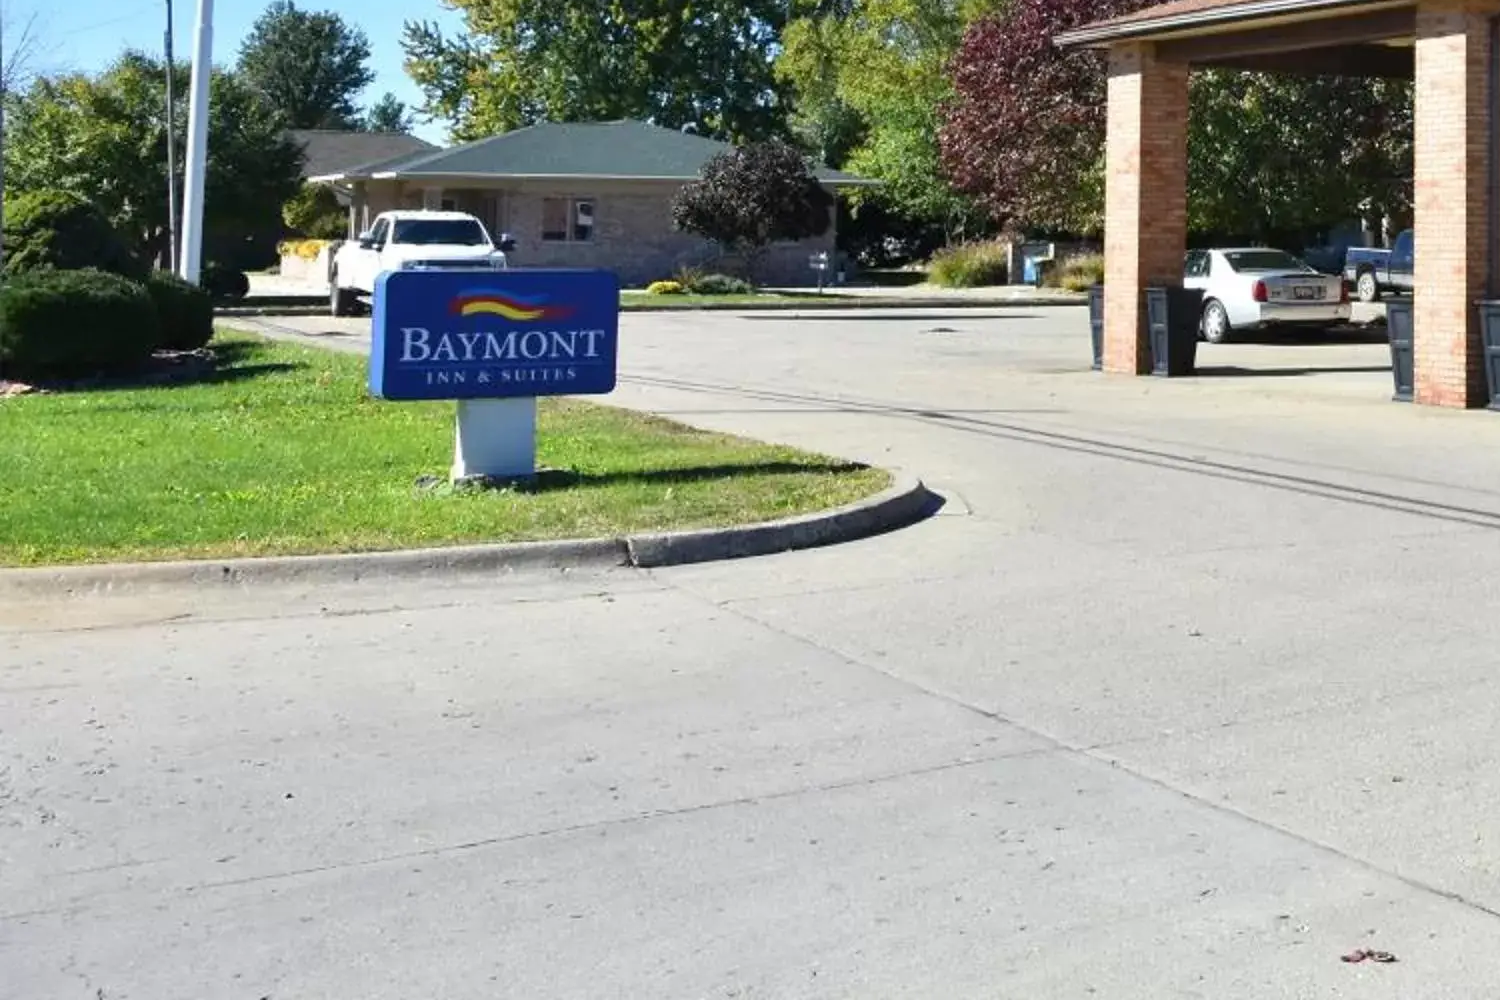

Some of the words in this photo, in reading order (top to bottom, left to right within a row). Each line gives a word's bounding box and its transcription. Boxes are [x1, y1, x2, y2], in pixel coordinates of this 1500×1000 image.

[400, 327, 605, 362] BAYMONT
[427, 370, 466, 385] INN
[478, 371, 491, 384] &
[501, 368, 577, 382] SUITES
